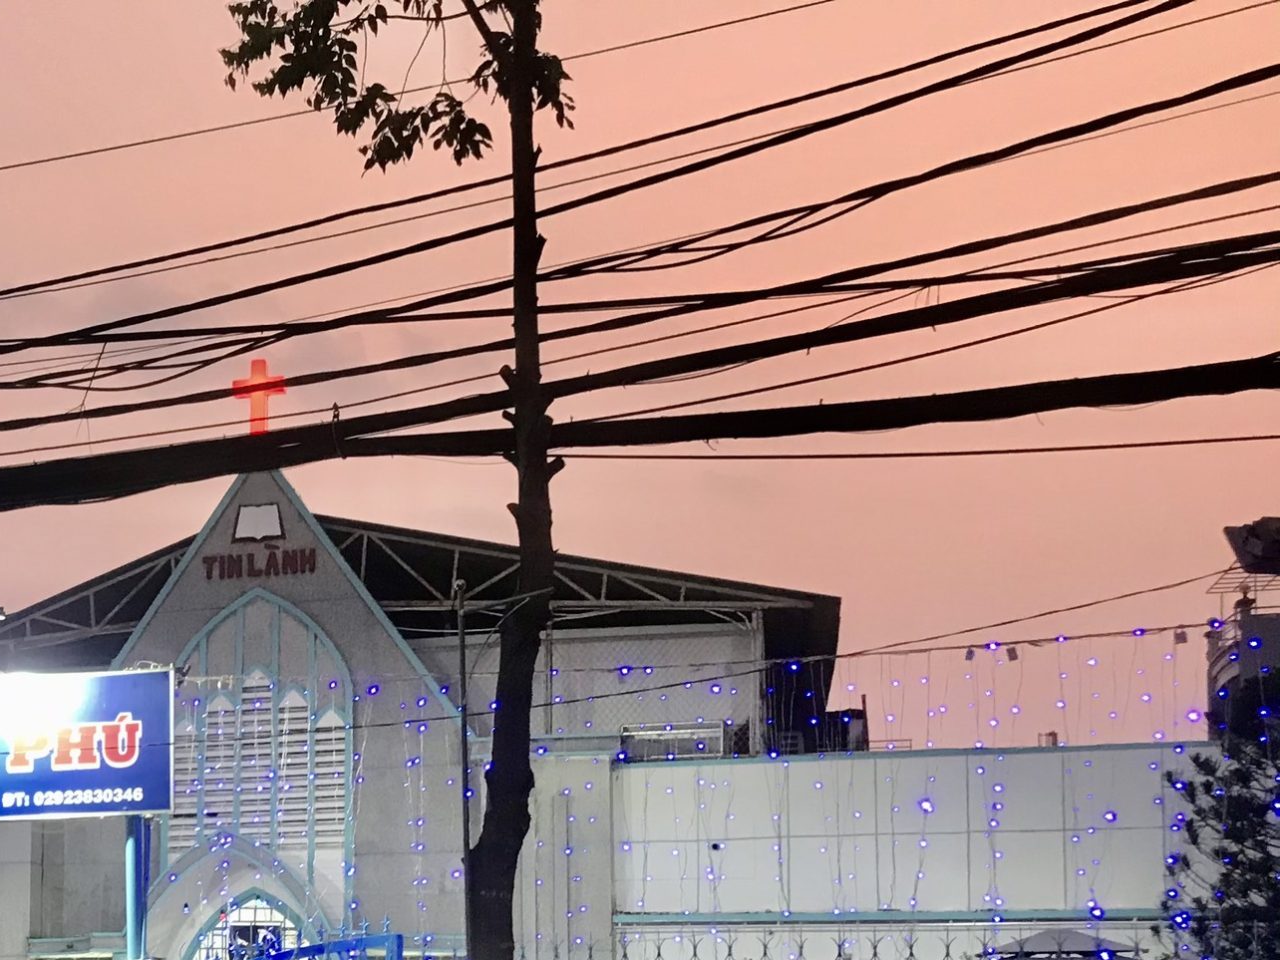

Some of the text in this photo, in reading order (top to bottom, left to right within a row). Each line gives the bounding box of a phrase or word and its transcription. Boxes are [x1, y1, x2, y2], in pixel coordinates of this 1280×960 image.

[202, 543, 317, 581] TIN LÀNH
[7, 712, 142, 774] PHÚ
